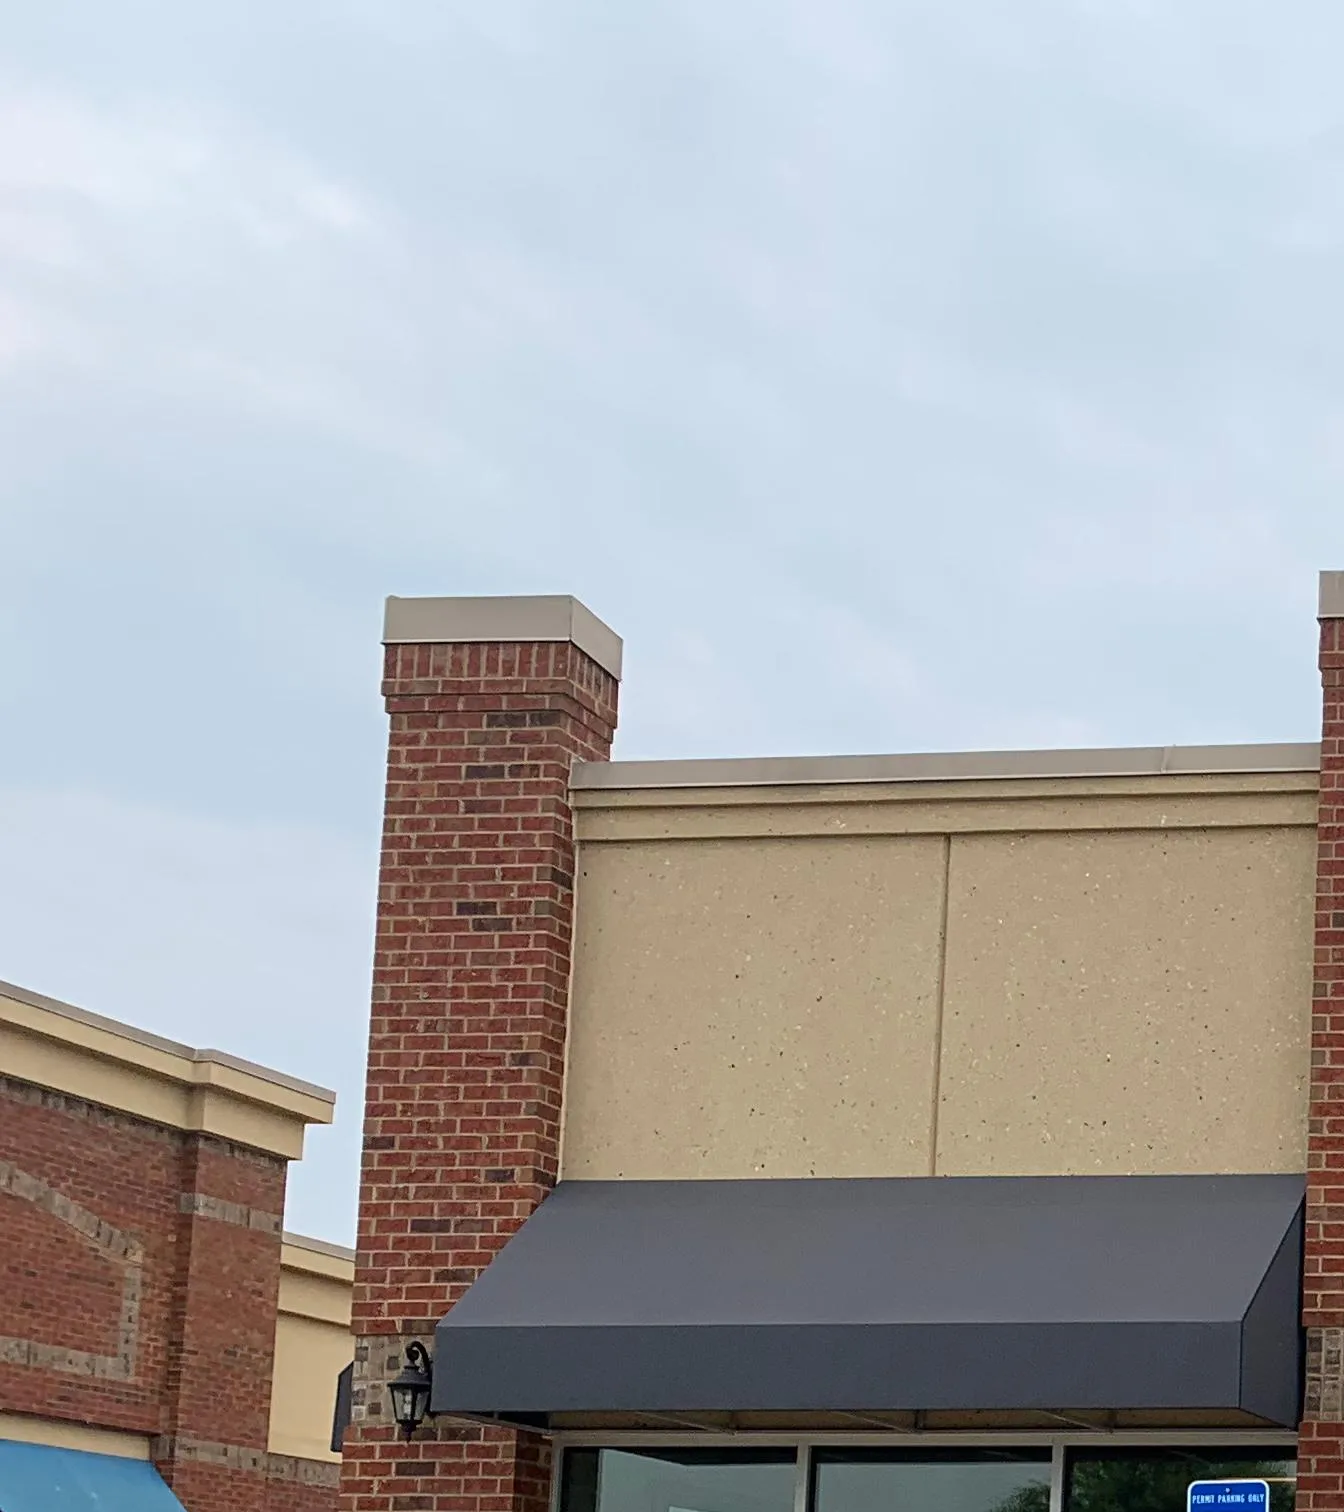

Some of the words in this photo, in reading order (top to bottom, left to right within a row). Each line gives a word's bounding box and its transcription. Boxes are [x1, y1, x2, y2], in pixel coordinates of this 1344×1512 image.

[1192, 1495, 1215, 1504] PERMIT
[1217, 1494, 1245, 1503] PARKING
[1247, 1493, 1265, 1503] ONLY
